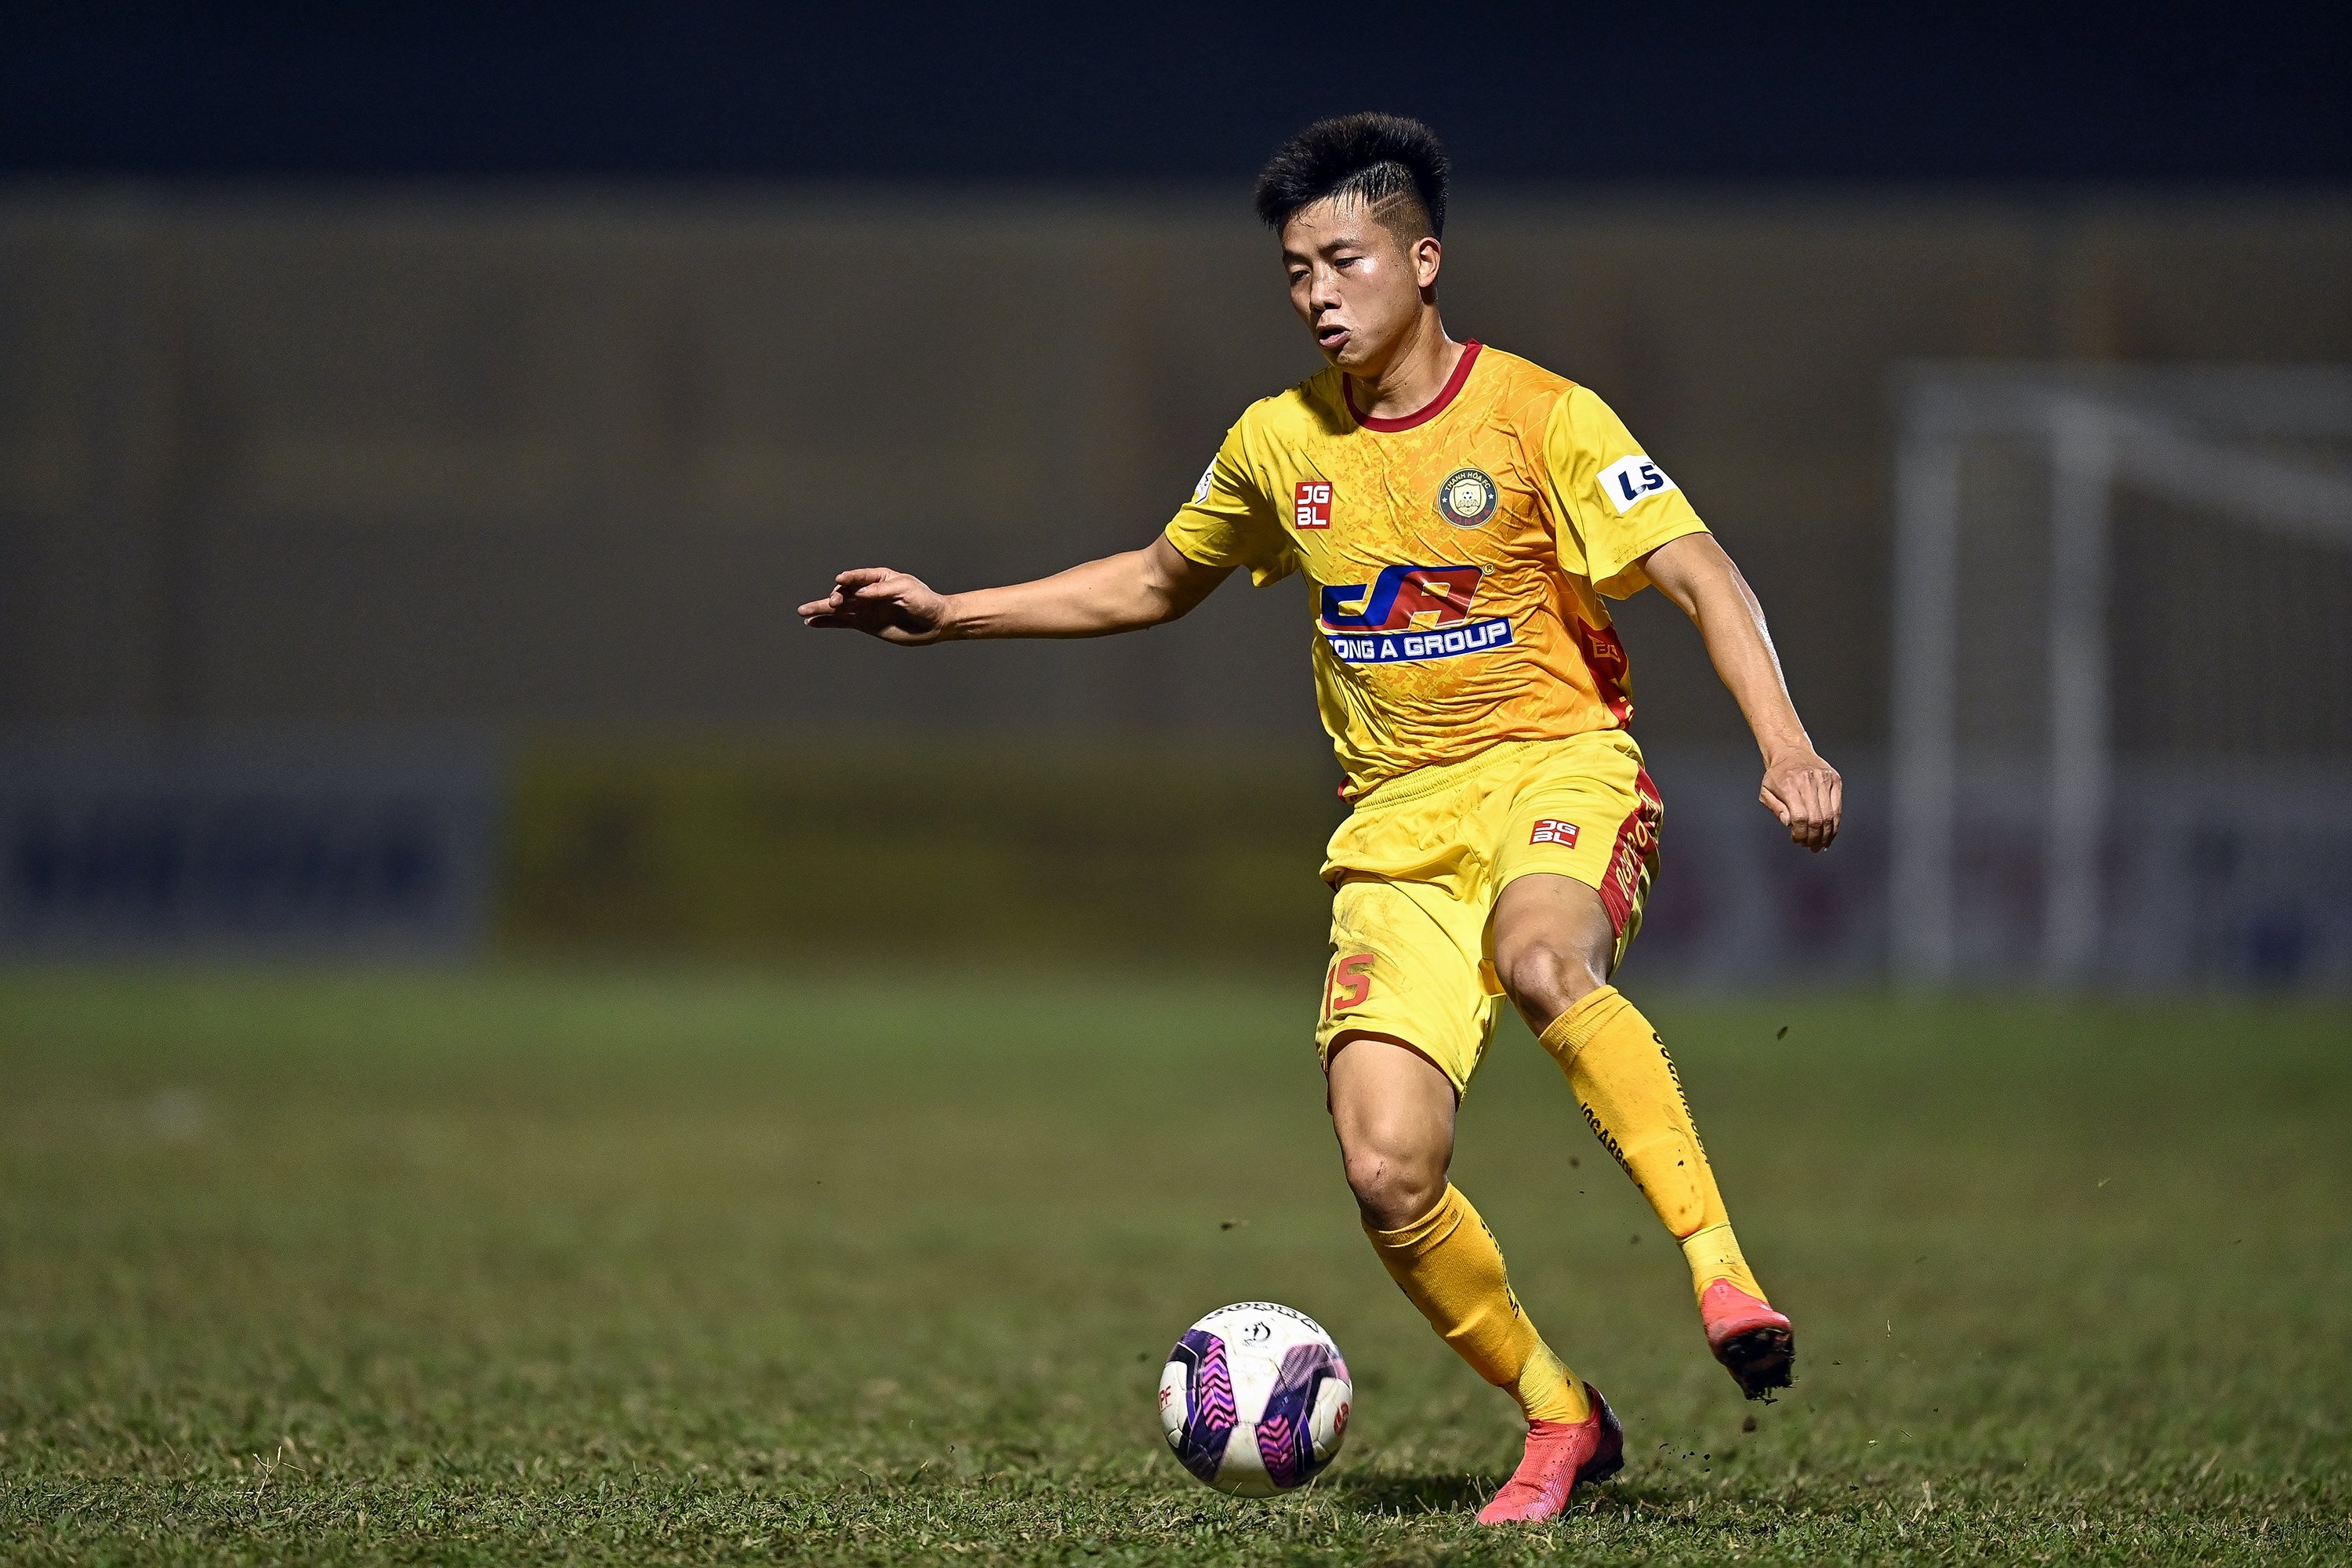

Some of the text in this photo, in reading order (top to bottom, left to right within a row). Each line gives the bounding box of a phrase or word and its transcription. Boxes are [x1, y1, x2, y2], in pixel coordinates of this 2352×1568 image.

[1445, 473, 1465, 491] THANH
[1482, 480, 1491, 489] FC
[1298, 485, 1330, 505] JG
[1298, 506, 1327, 526] BL
[1328, 622, 1508, 659] ONG A GROUP
[1535, 820, 1577, 836] JG
[1533, 831, 1573, 846] BL
